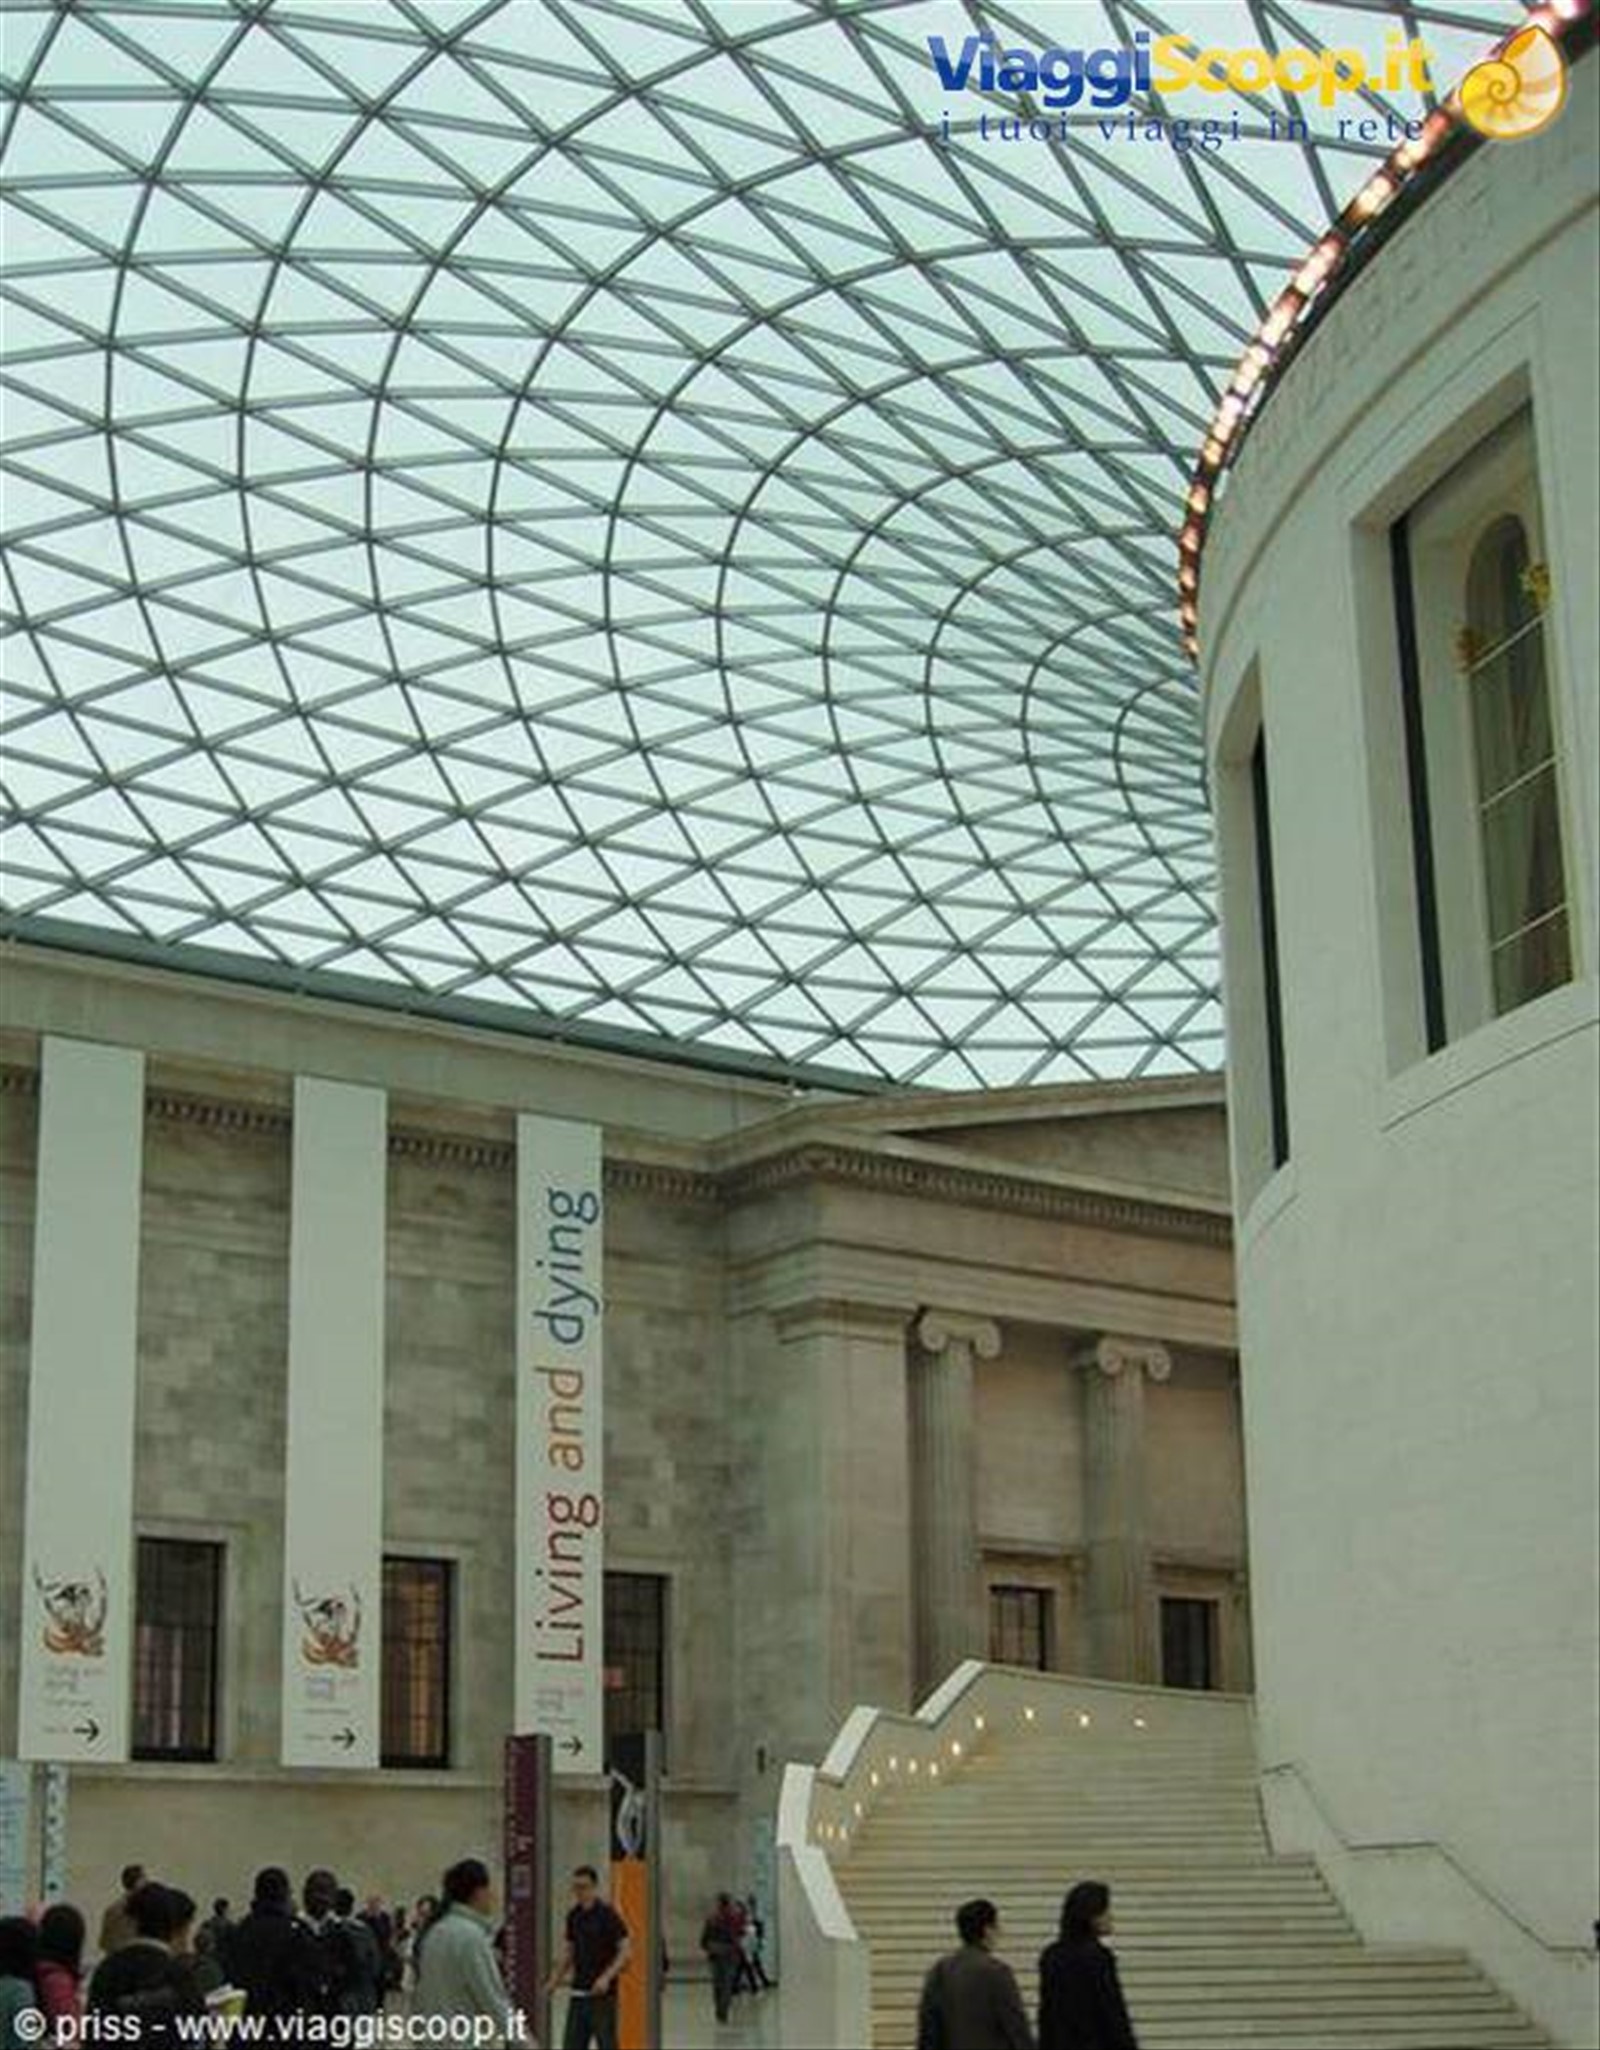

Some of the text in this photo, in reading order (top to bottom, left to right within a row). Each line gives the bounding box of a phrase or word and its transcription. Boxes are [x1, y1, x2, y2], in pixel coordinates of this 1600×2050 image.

[533, 1187, 599, 1344] dying
[534, 1366, 584, 1472] and
[535, 1492, 600, 1662] Living
